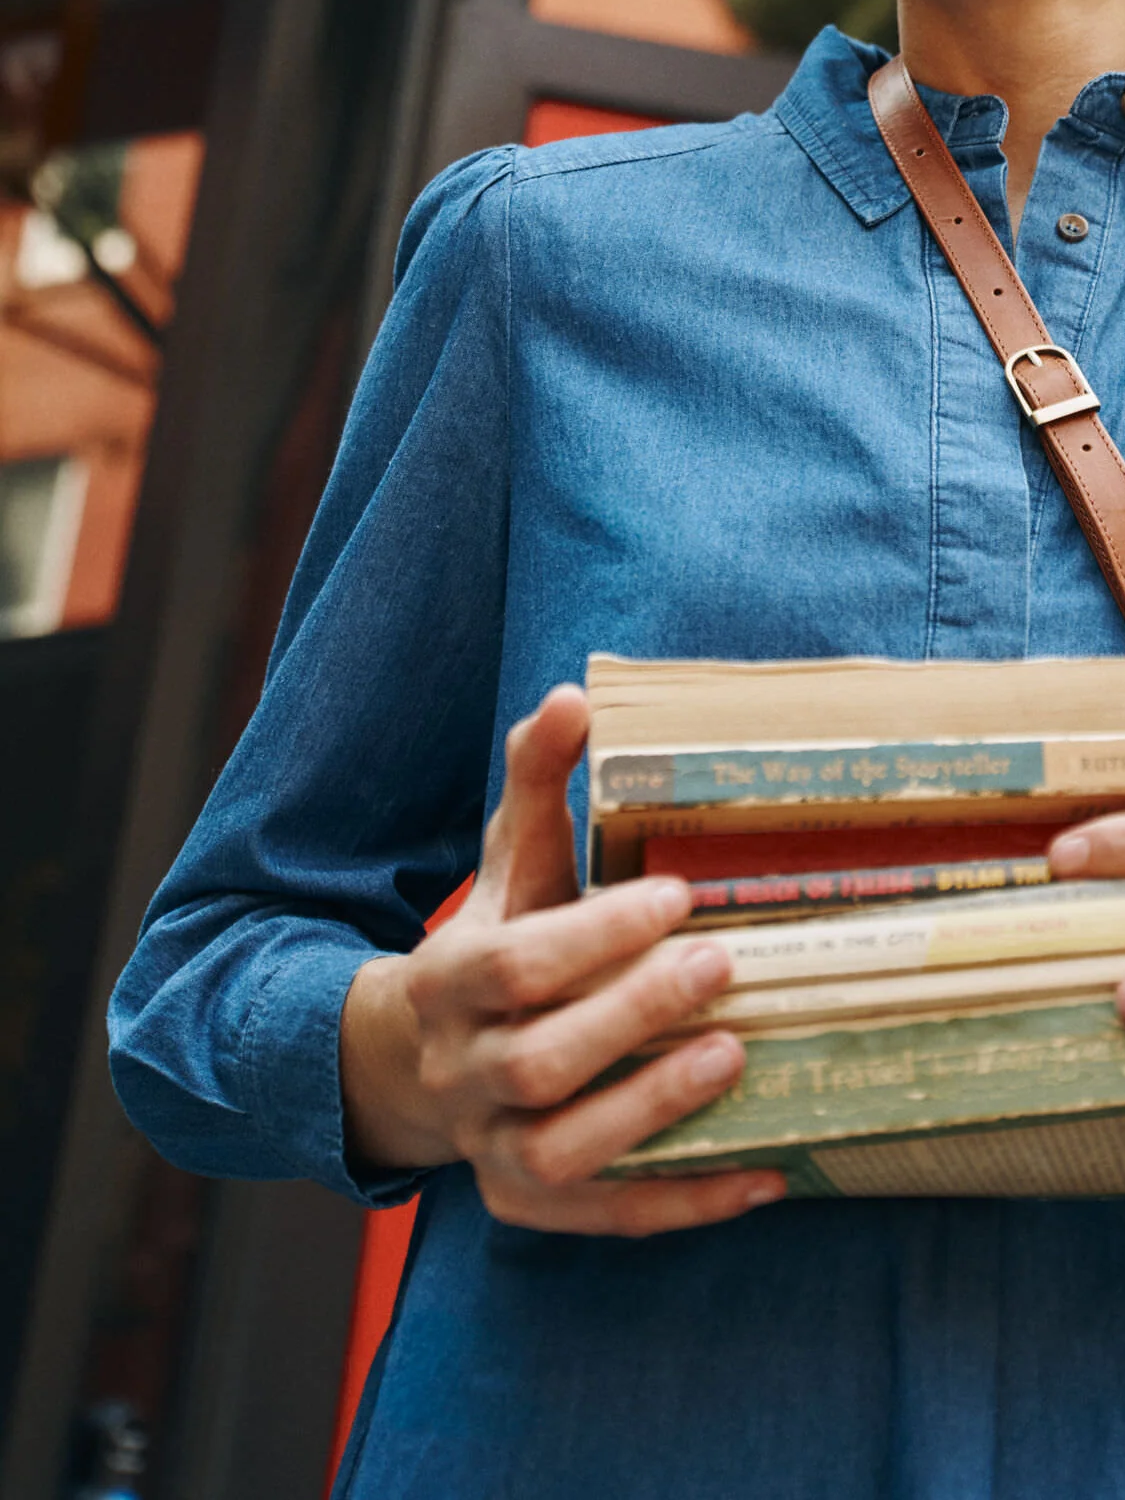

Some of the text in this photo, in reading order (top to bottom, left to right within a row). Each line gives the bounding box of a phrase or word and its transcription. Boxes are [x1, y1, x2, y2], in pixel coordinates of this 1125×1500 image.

[712, 759, 754, 786] The
[761, 760, 812, 787] Way
[819, 756, 844, 782] of
[895, 753, 1011, 780] Storyteller
[755, 1061, 791, 1099] of
[804, 1048, 916, 1094] Travel
